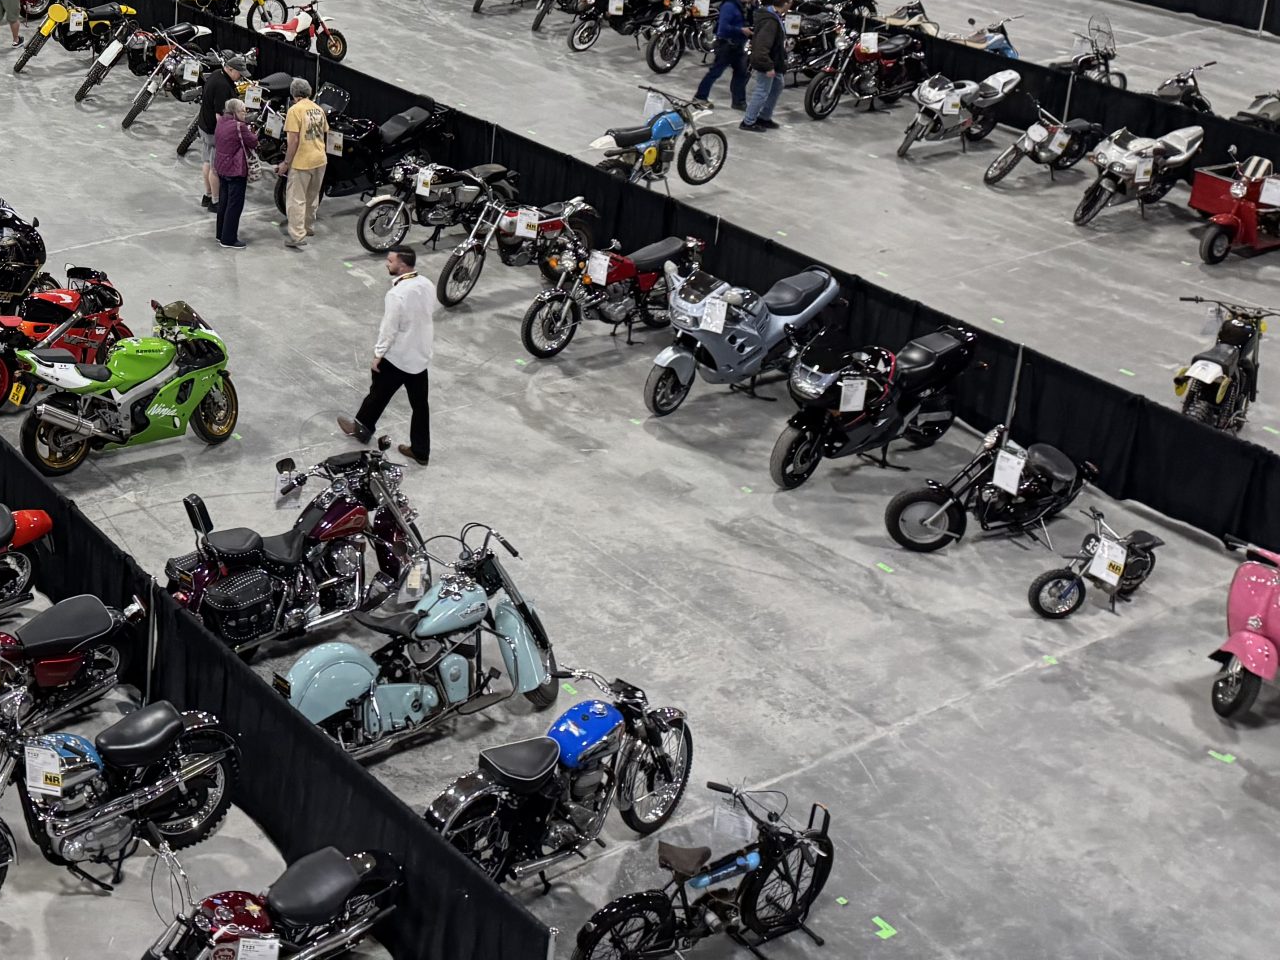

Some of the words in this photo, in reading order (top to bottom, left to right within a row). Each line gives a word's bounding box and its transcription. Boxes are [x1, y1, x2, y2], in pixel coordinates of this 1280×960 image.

[148, 404, 177, 417] Ninja
[1109, 563, 1122, 572] NR
[45, 775, 60, 784] NR
